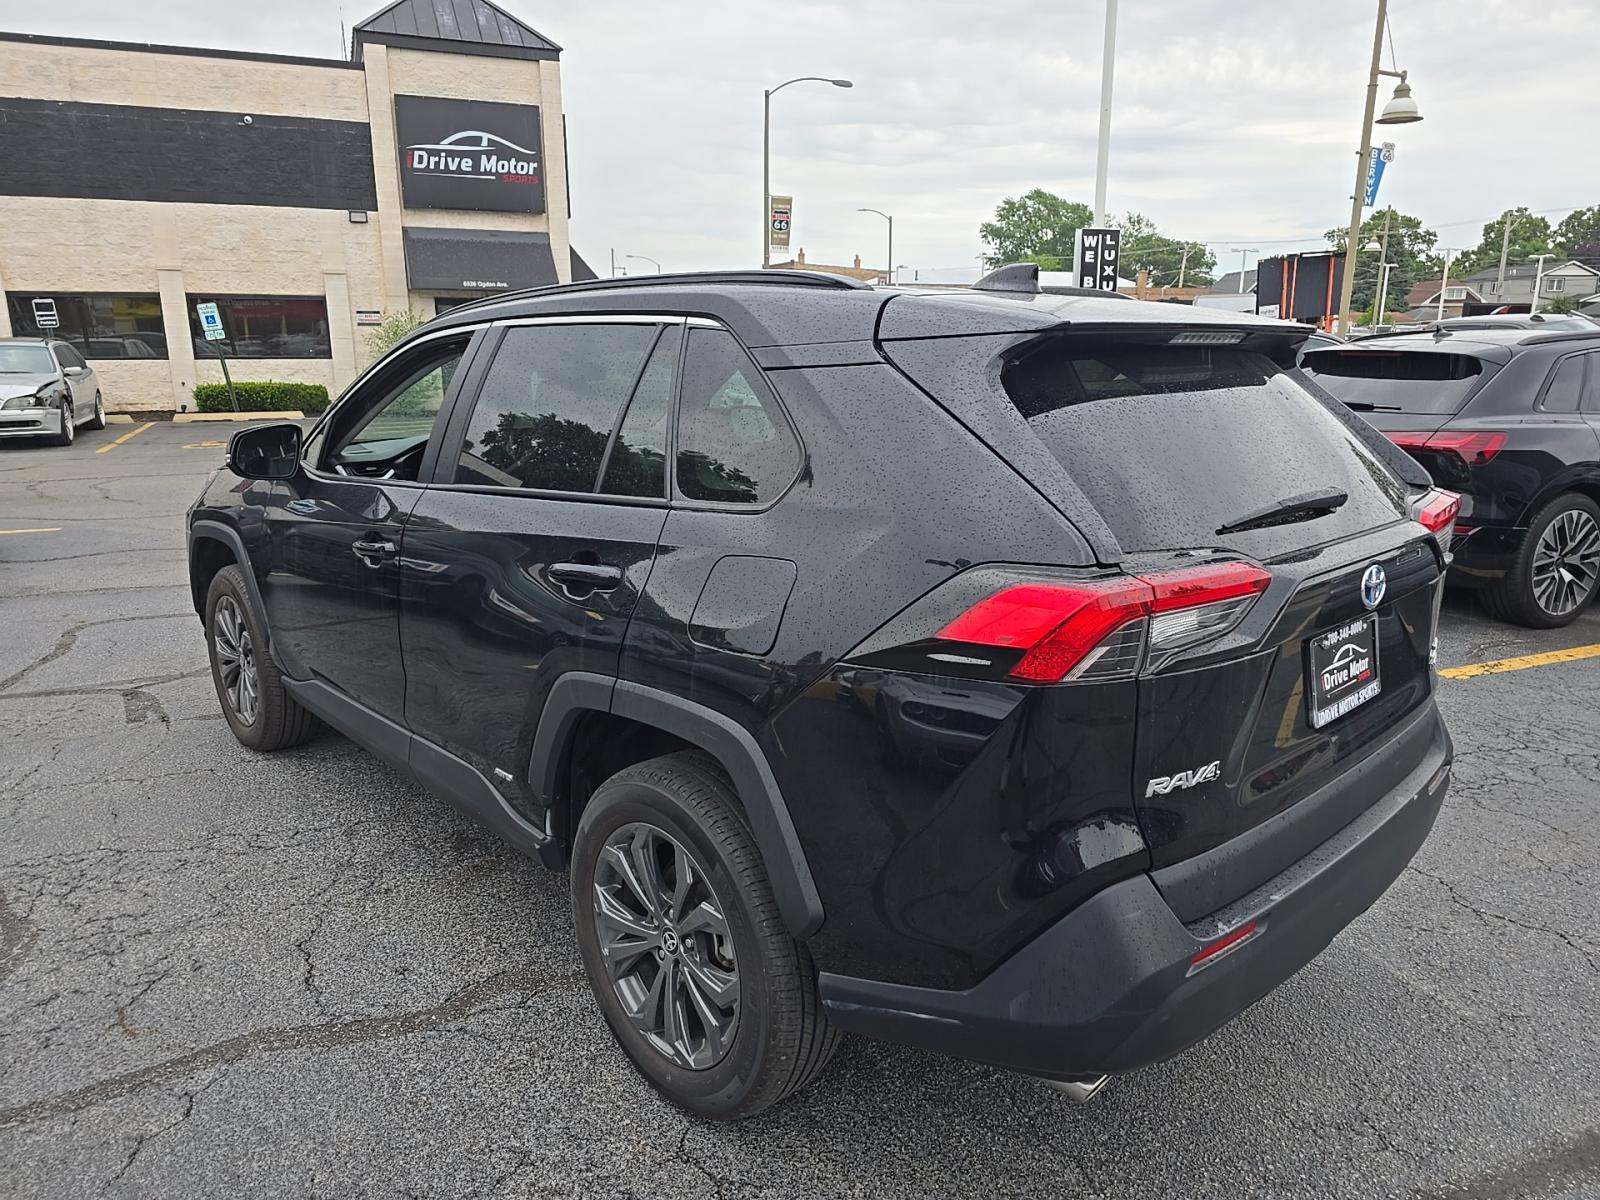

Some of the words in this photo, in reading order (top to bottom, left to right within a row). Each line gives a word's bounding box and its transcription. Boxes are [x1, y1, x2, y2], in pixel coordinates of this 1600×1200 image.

[407, 150, 472, 172] iDrive
[480, 154, 538, 175] Motor
[503, 174, 540, 184] SPORTS
[1365, 149, 1378, 205] BERWYN
[774, 221, 787, 229] 66
[1083, 235, 1098, 263] WE
[1349, 657, 1369, 678] Motor
[1339, 693, 1359, 715] MOTOR
[1358, 681, 1379, 704] SPORTS
[1144, 760, 1221, 798] RAV4
